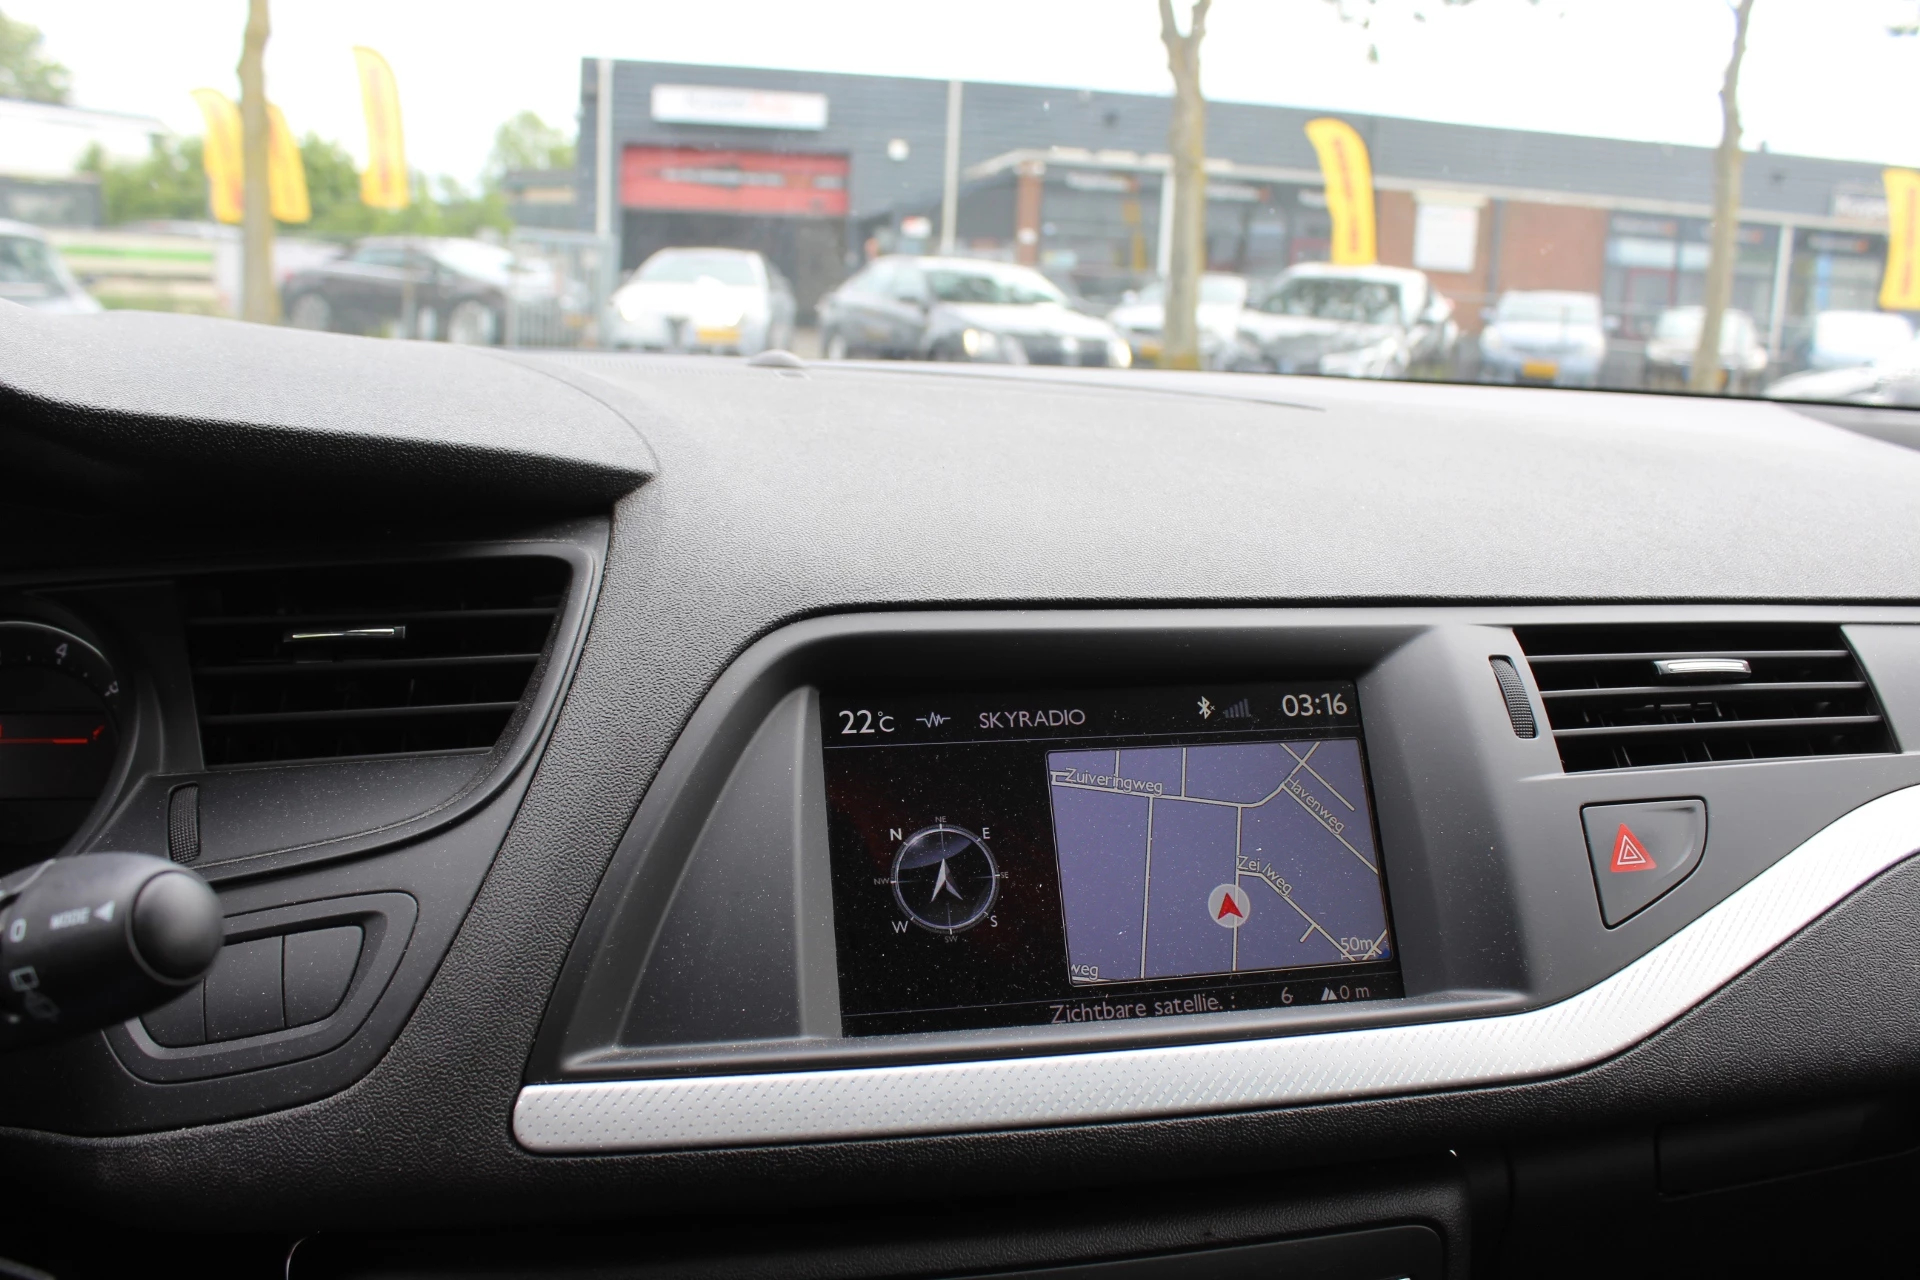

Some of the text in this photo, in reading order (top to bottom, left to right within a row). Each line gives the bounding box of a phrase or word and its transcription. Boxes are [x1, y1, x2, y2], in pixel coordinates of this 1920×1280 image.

[55, 643, 68, 658] 4
[1281, 692, 1348, 718] 03:16
[978, 708, 1086, 730] SKYRADIO
[1064, 766, 1163, 797] Zuiveringweg
[1283, 774, 1345, 835] Havenweg
[934, 815, 947, 824] NE
[889, 827, 903, 842] N
[981, 827, 991, 840] E
[873, 876, 890, 886] NW
[1000, 871, 1009, 879] SE
[50, 907, 90, 930] MODE
[989, 914, 999, 929] S
[891, 920, 909, 934] W
[944, 935, 958, 944] SW
[1340, 936, 1374, 952] 50m
[1339, 984, 1370, 1000] 0 m
[1050, 1001, 1147, 1024] Zichtbare
[1281, 986, 1294, 1005] 6
